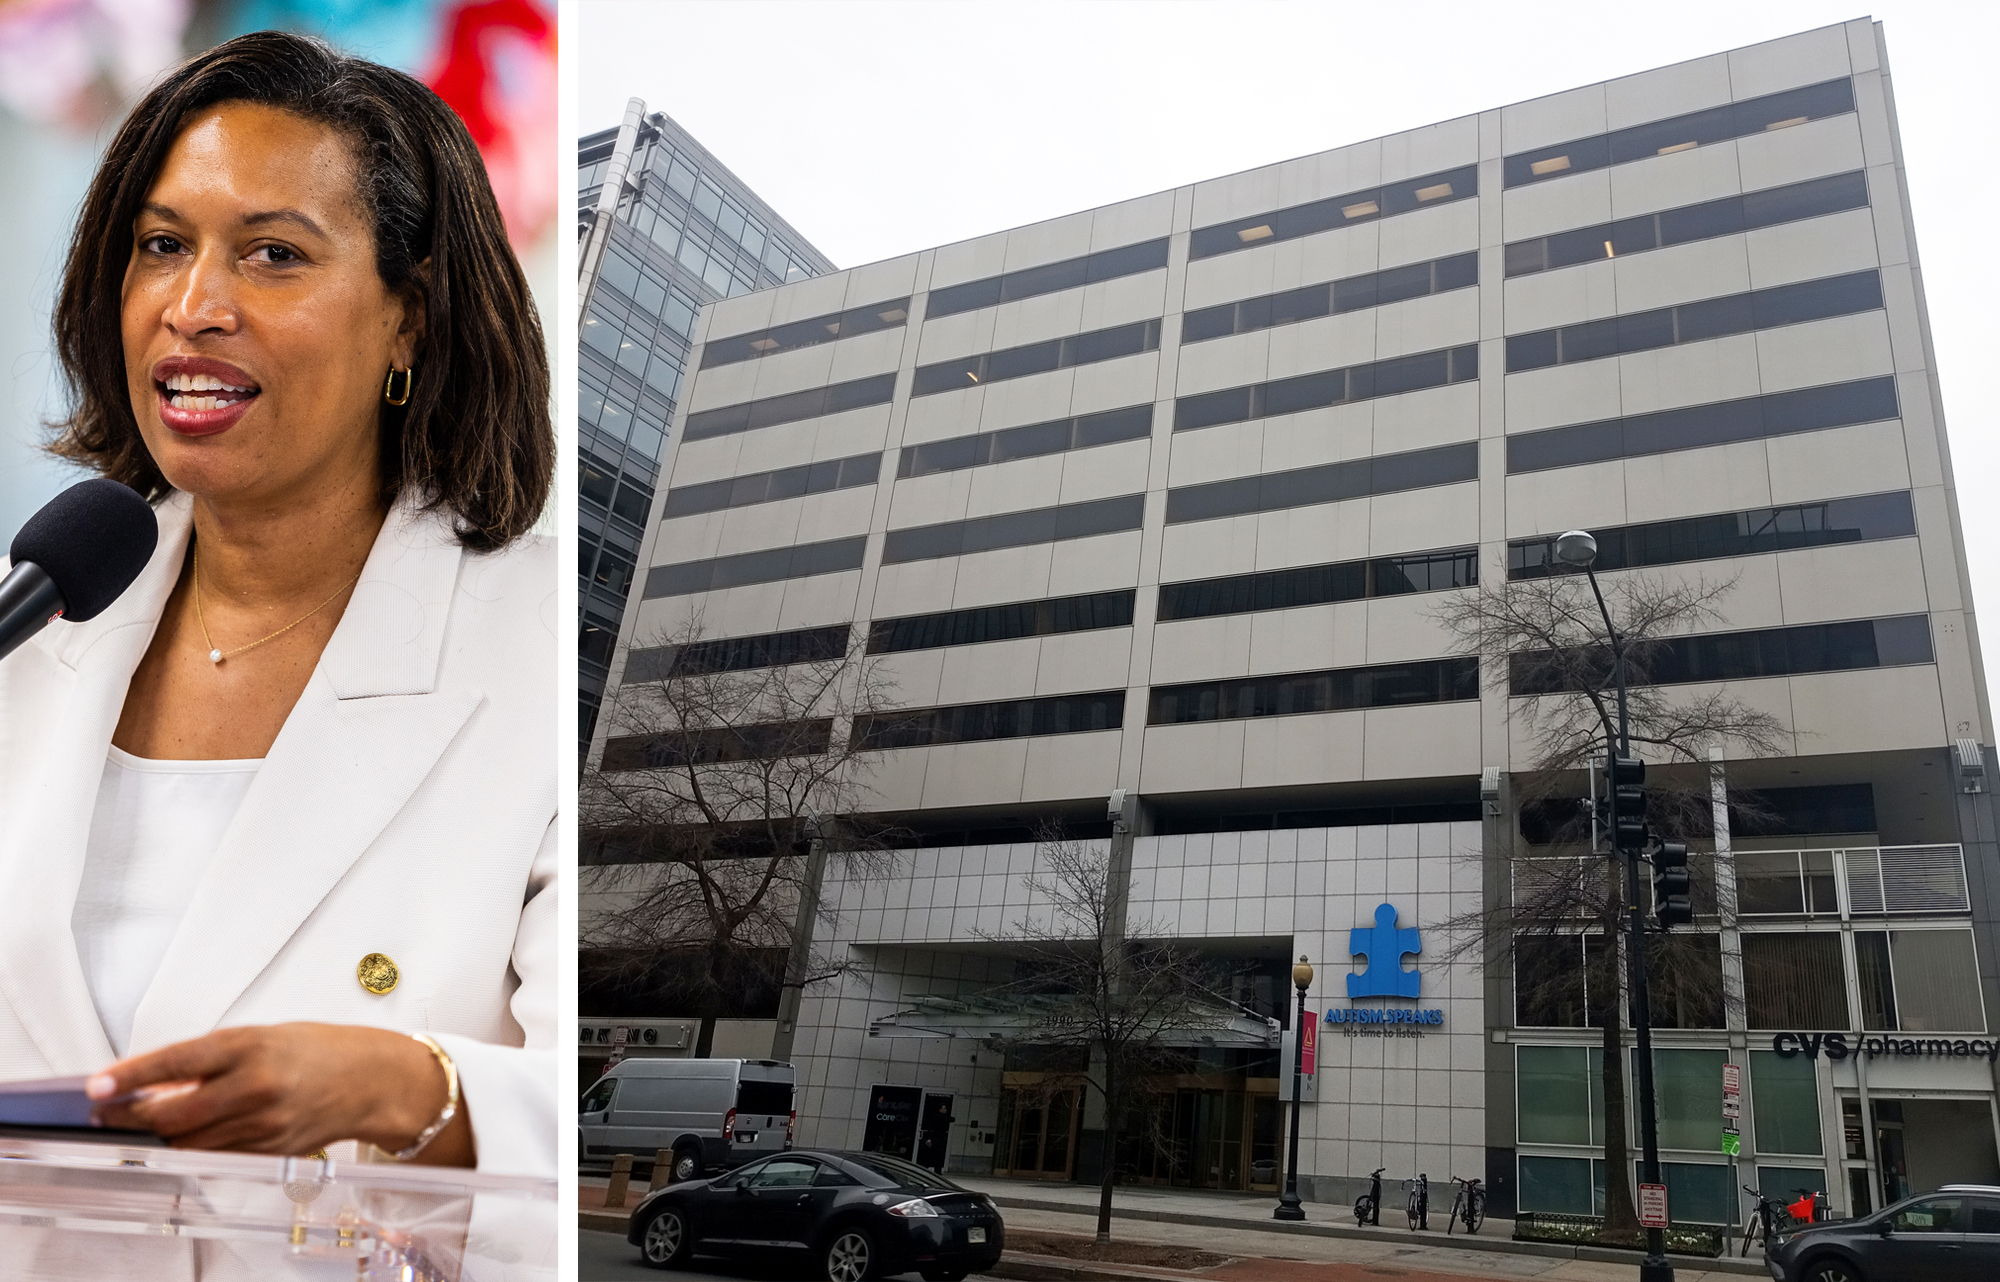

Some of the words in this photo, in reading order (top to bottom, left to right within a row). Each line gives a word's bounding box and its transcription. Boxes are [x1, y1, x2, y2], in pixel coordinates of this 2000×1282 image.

[1325, 1009, 1383, 1024] AUTISM
[1385, 1009, 1443, 1025] SPEAKS
[579, 1027, 658, 1045] RKNG
[1343, 1028, 1358, 1038] It's
[1360, 1028, 1381, 1038] time
[1383, 1028, 1394, 1038] to
[1396, 1028, 1425, 1039] listen.
